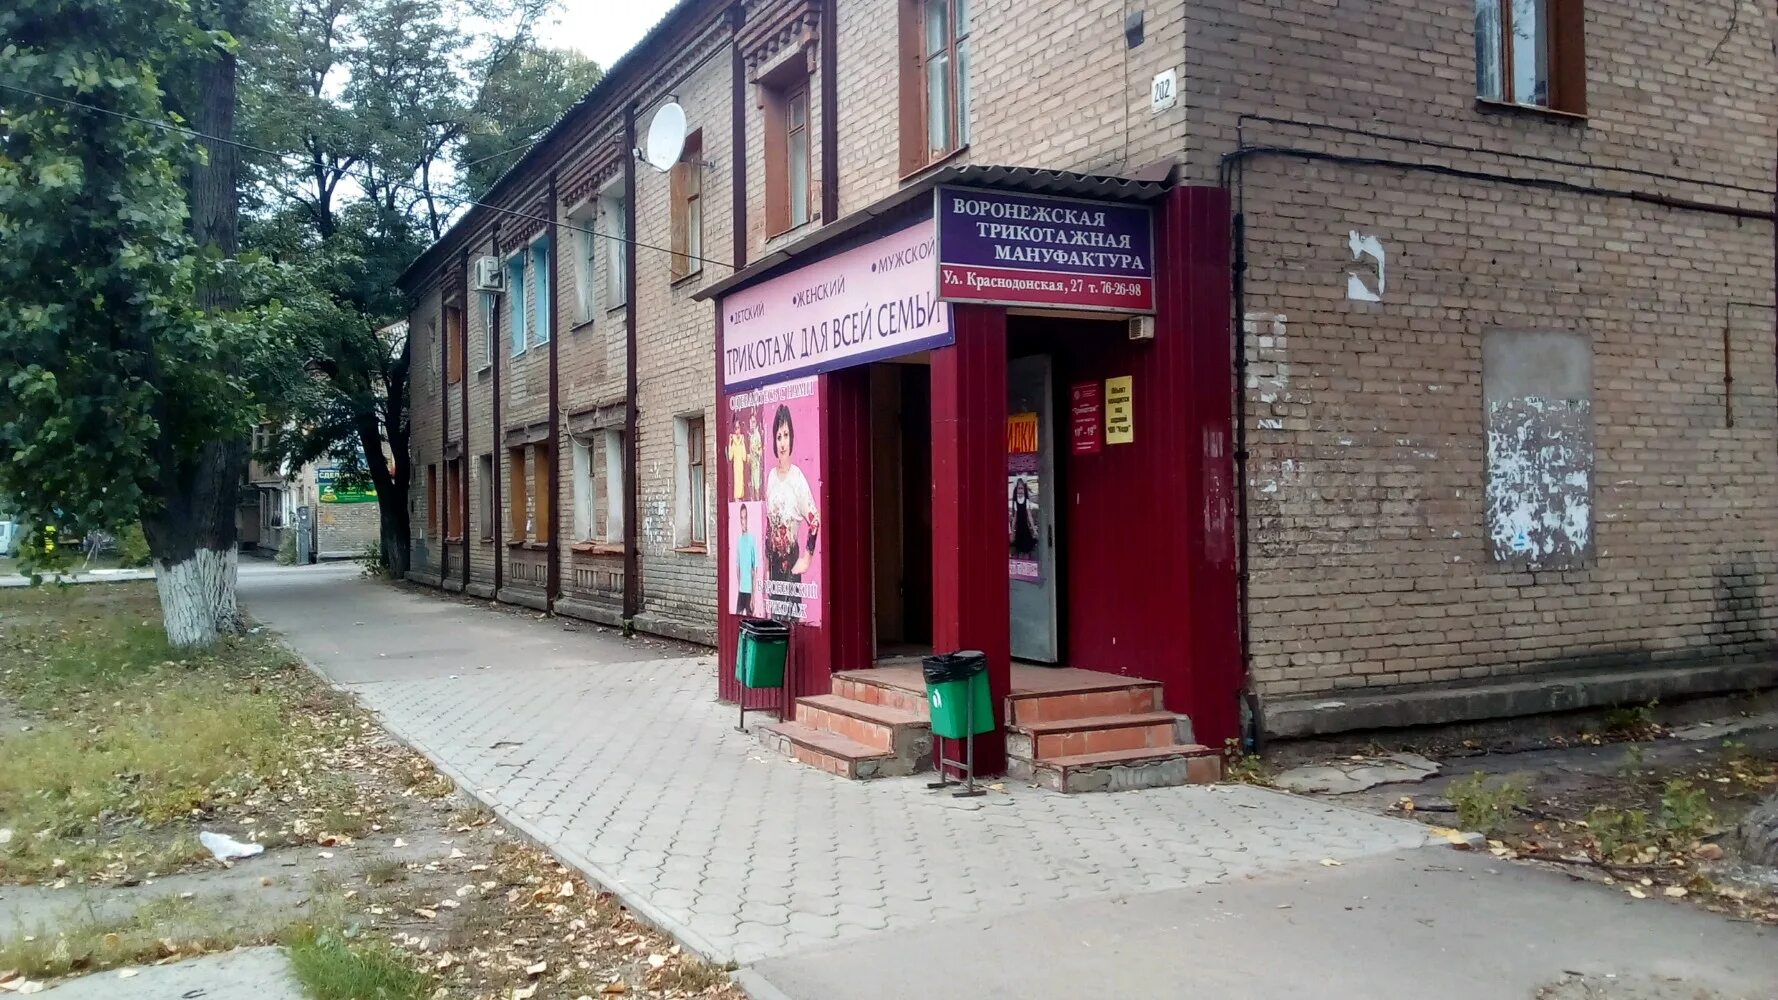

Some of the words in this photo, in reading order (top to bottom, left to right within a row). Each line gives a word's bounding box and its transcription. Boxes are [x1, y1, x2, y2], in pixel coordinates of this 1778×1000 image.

[1154, 78, 1171, 103] 202
[952, 198, 1106, 227] ВОРОНЕЖСКАЯ
[976, 222, 1131, 249] ТРИКОТАЖНАЯ
[994, 244, 1145, 270] МАНУФАКТУРА
[734, 300, 765, 325] ДЕТСКИЙ
[796, 274, 846, 308] ЖЕНСКИЙ
[878, 236, 936, 274] МУЖСКОЙ
[943, 270, 963, 285] Ул.
[966, 271, 1069, 294] Краснодонская,
[1070, 279, 1084, 293] 27
[1088, 283, 1099, 294] т.
[1100, 281, 1142, 296] 76-26-98
[726, 331, 796, 375] ТРИКОТАЖ
[800, 321, 829, 359] ДЛЯ
[832, 301, 873, 349] ВСЕЙ
[877, 291, 941, 337] СЕМЬИ
